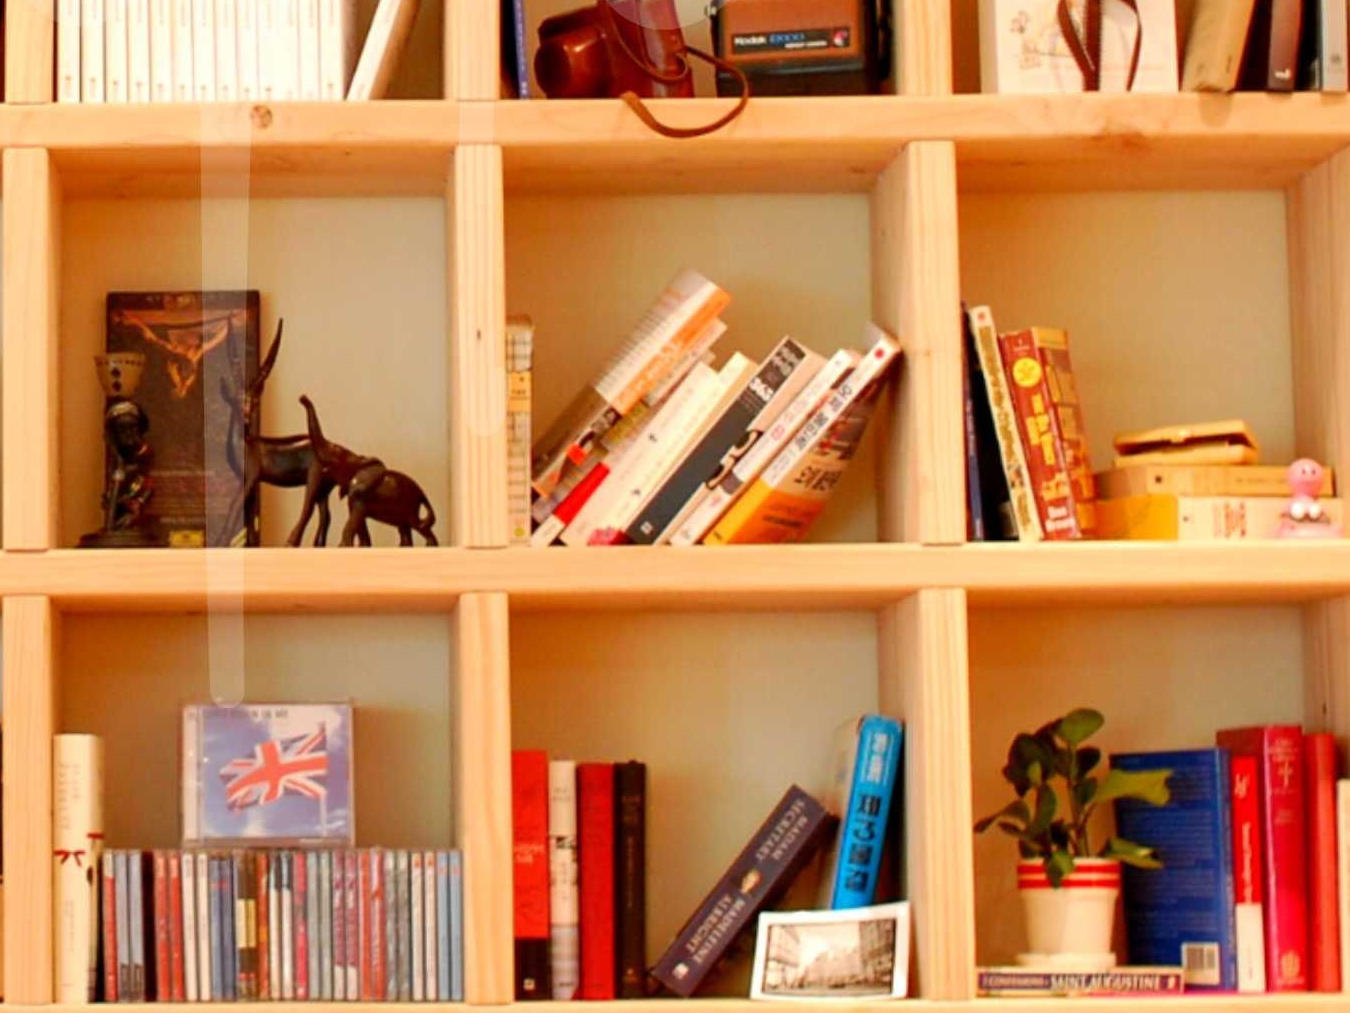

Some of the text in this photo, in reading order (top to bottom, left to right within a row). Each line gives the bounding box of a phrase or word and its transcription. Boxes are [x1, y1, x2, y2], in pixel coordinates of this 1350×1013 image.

[734, 36, 767, 45] Kodak
[755, 798, 805, 862] SECRETARY
[771, 814, 808, 860] MADAM
[686, 893, 732, 952] ALBRIGHT
[693, 898, 745, 963] MADELEINE
[1051, 974, 1088, 990] SAINT
[1090, 973, 1159, 991] AUGUSTINE
